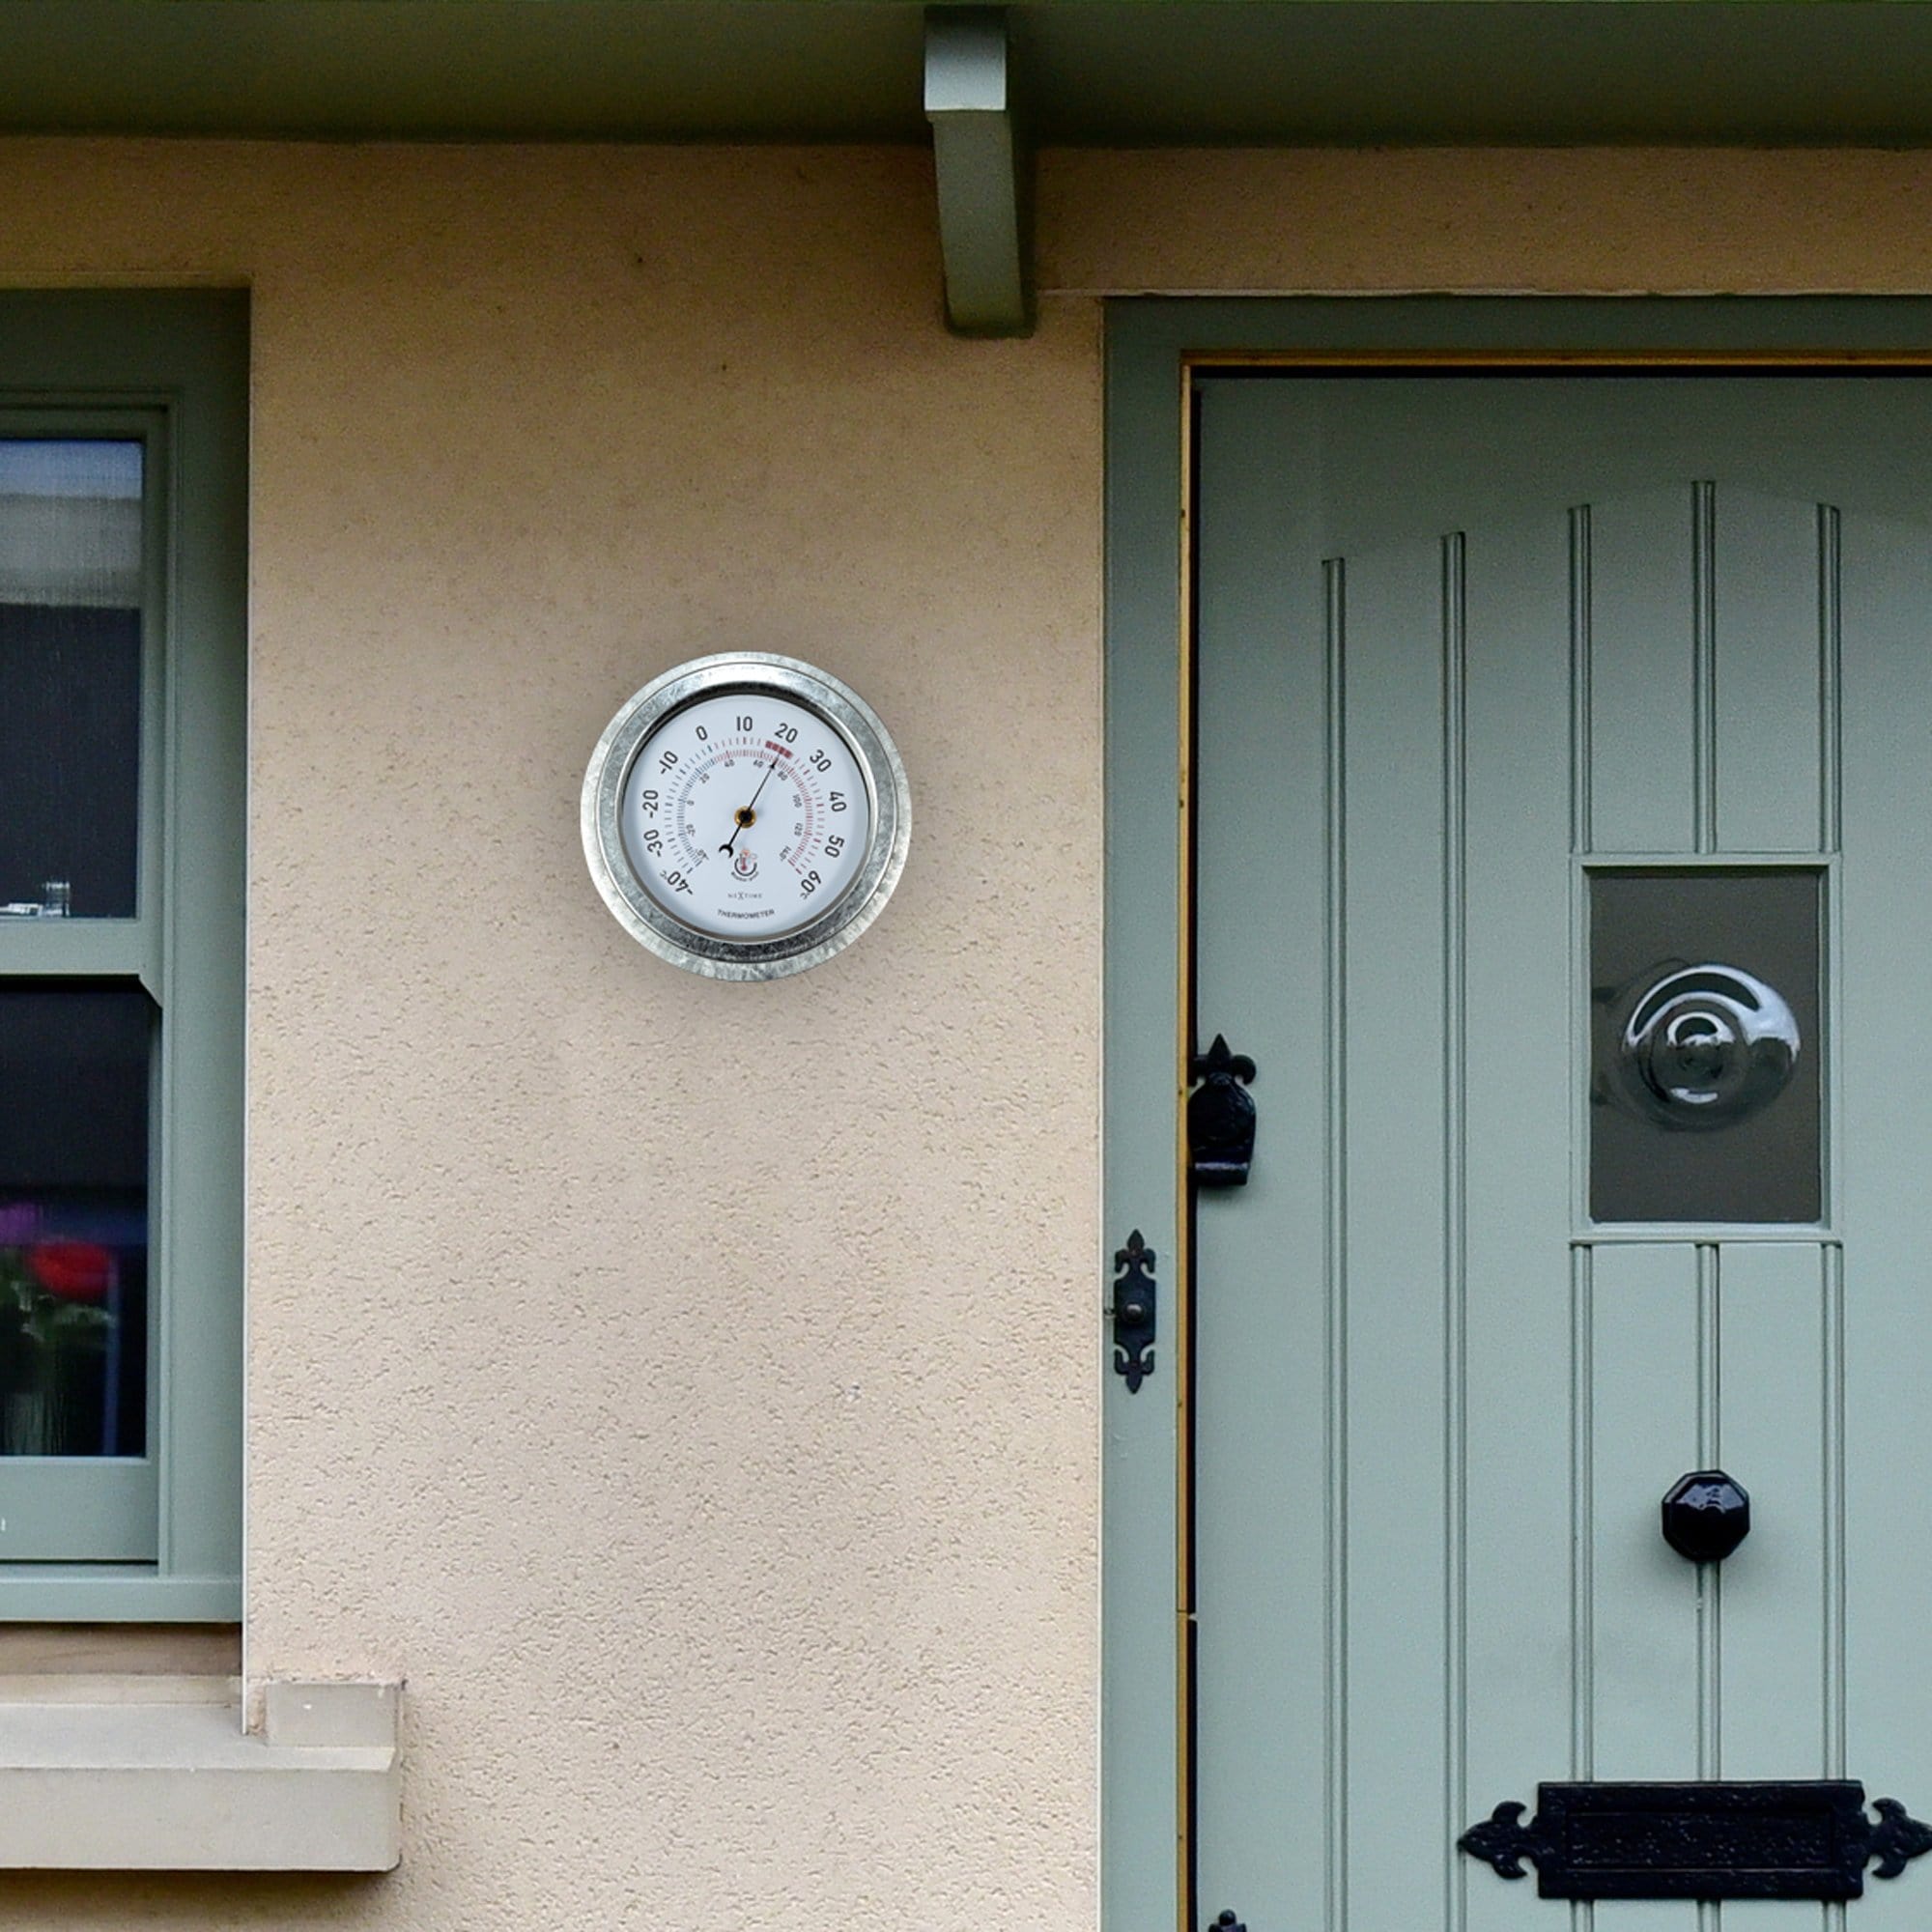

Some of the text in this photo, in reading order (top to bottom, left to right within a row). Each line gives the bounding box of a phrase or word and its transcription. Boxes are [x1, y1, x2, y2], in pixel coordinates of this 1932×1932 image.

[696, 725, 708, 741] 0
[736, 716, 753, 731] 10
[774, 723, 799, 744] 20
[659, 751, 678, 775] -10
[810, 749, 832, 773] 30
[641, 789, 659, 818] -20
[829, 791, 847, 812] 40
[643, 829, 664, 858] -30
[824, 835, 845, 858] 50
[718, 908, 775, 920] THERMOMETER
